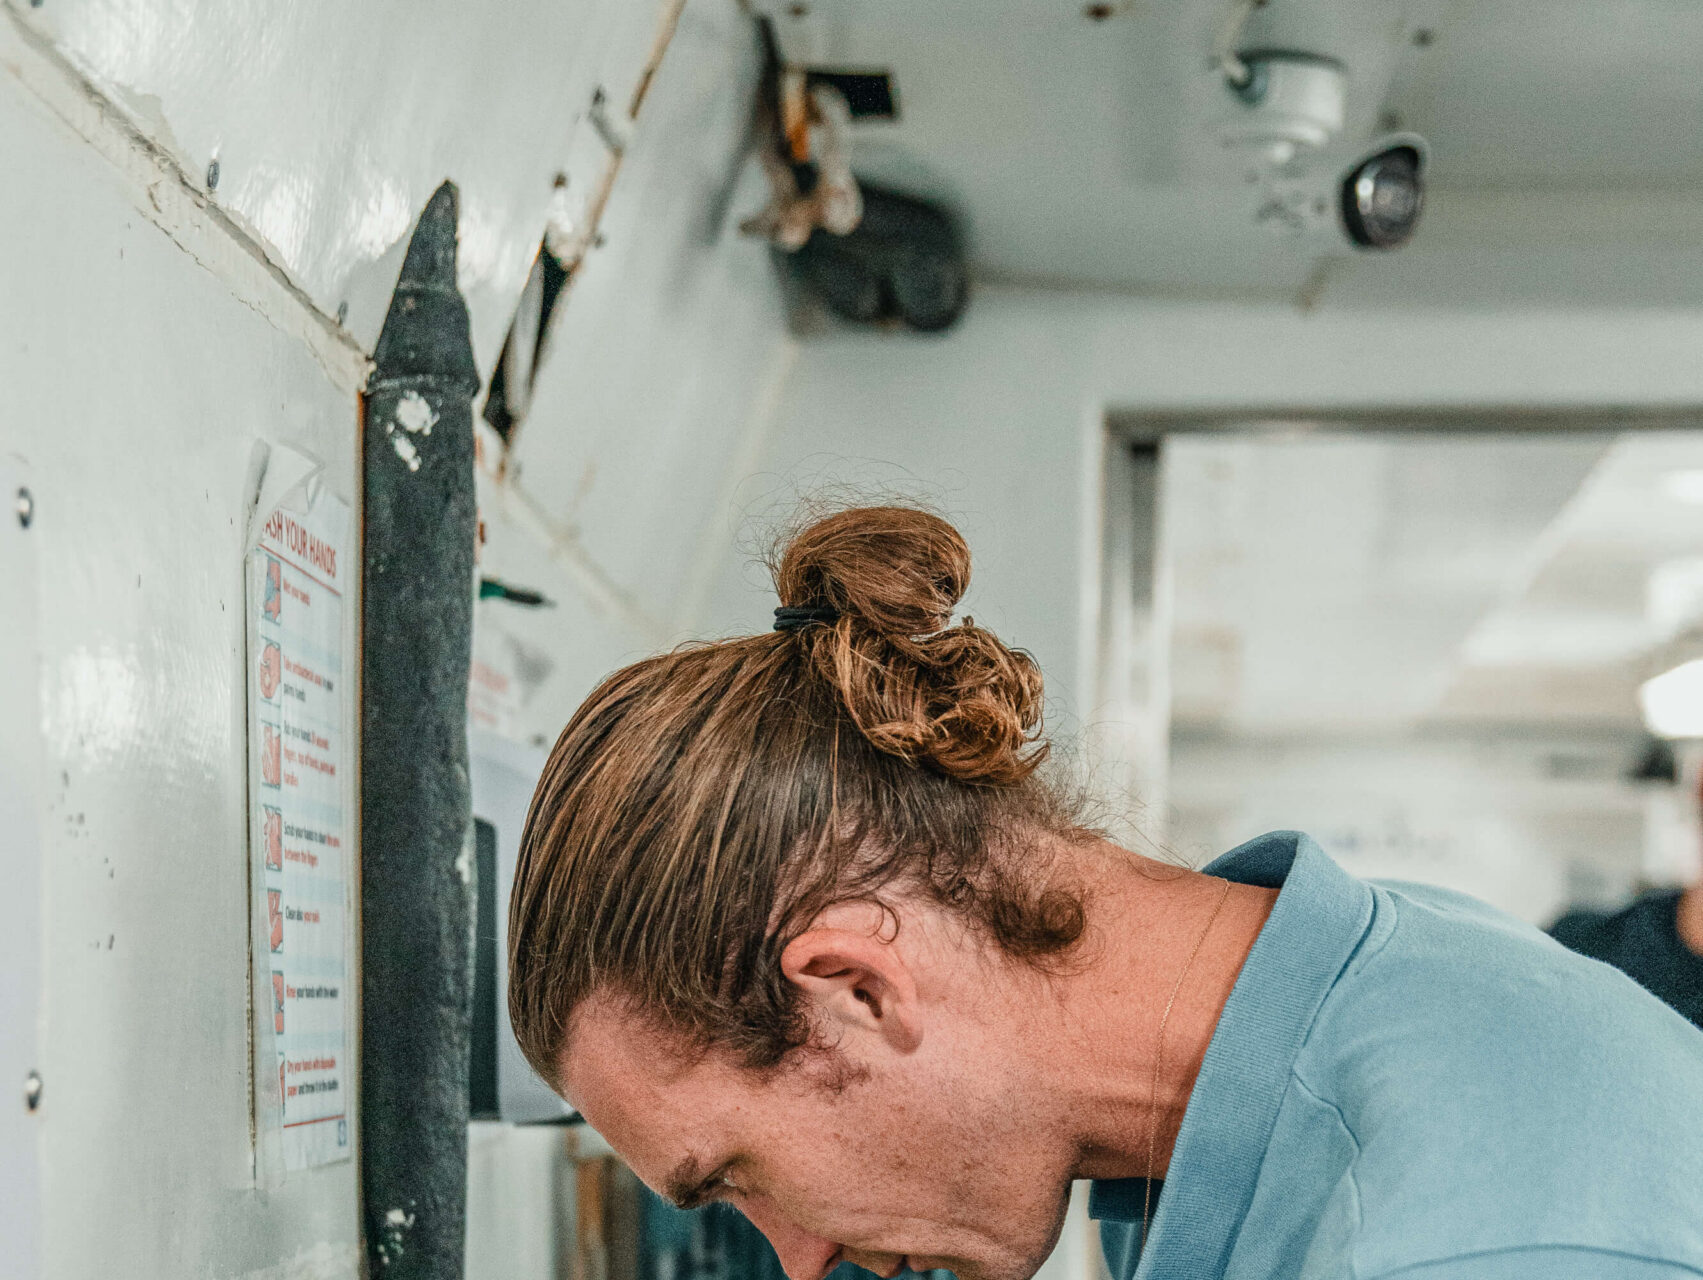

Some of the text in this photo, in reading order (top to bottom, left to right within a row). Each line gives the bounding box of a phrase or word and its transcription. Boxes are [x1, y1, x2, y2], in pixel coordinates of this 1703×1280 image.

[262, 510, 336, 579] ASH YOUR HANDS
